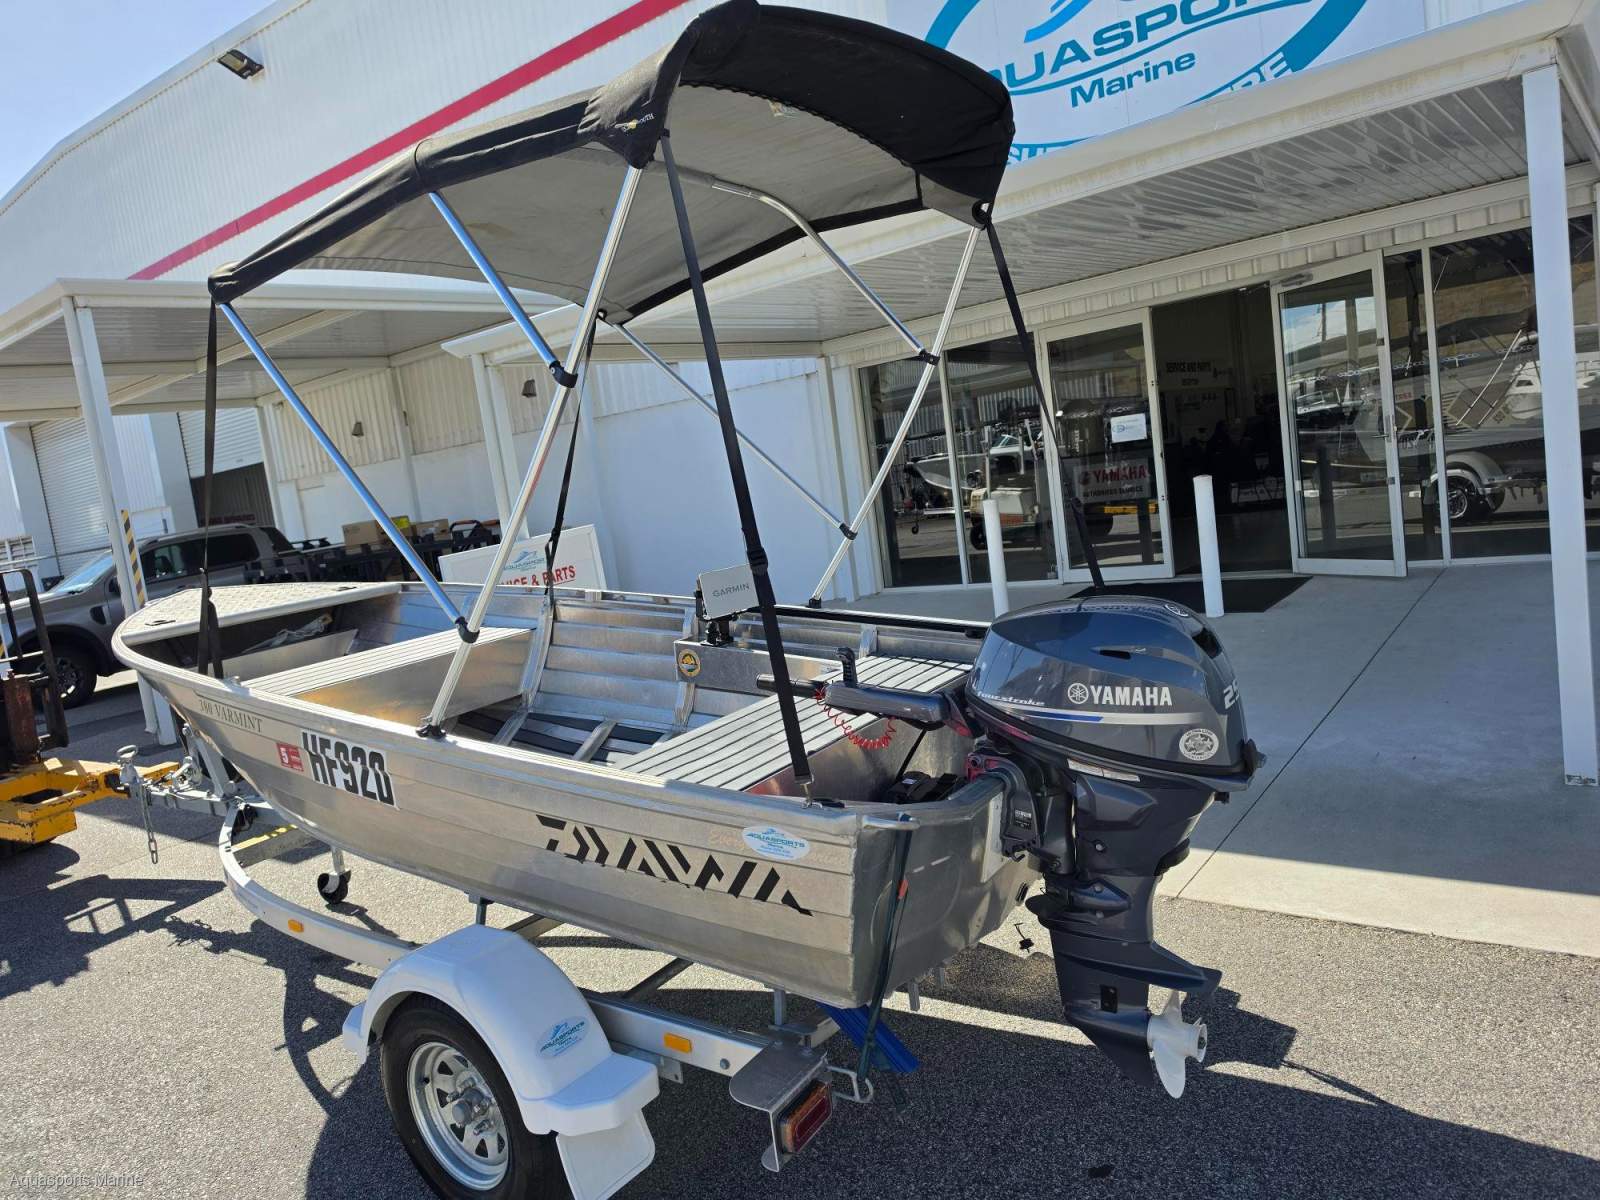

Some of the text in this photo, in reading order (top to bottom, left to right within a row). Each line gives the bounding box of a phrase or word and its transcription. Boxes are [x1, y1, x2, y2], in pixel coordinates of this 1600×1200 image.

[988, 0, 1248, 88] UASPO
[1071, 52, 1197, 108] Marine
[1094, 464, 1147, 483] YAMAHA
[531, 575, 540, 586] &
[712, 582, 750, 598] GARMIN
[1090, 685, 1173, 706] YAMAHA
[215, 704, 263, 733] VARMINT
[302, 732, 395, 806] HF920
